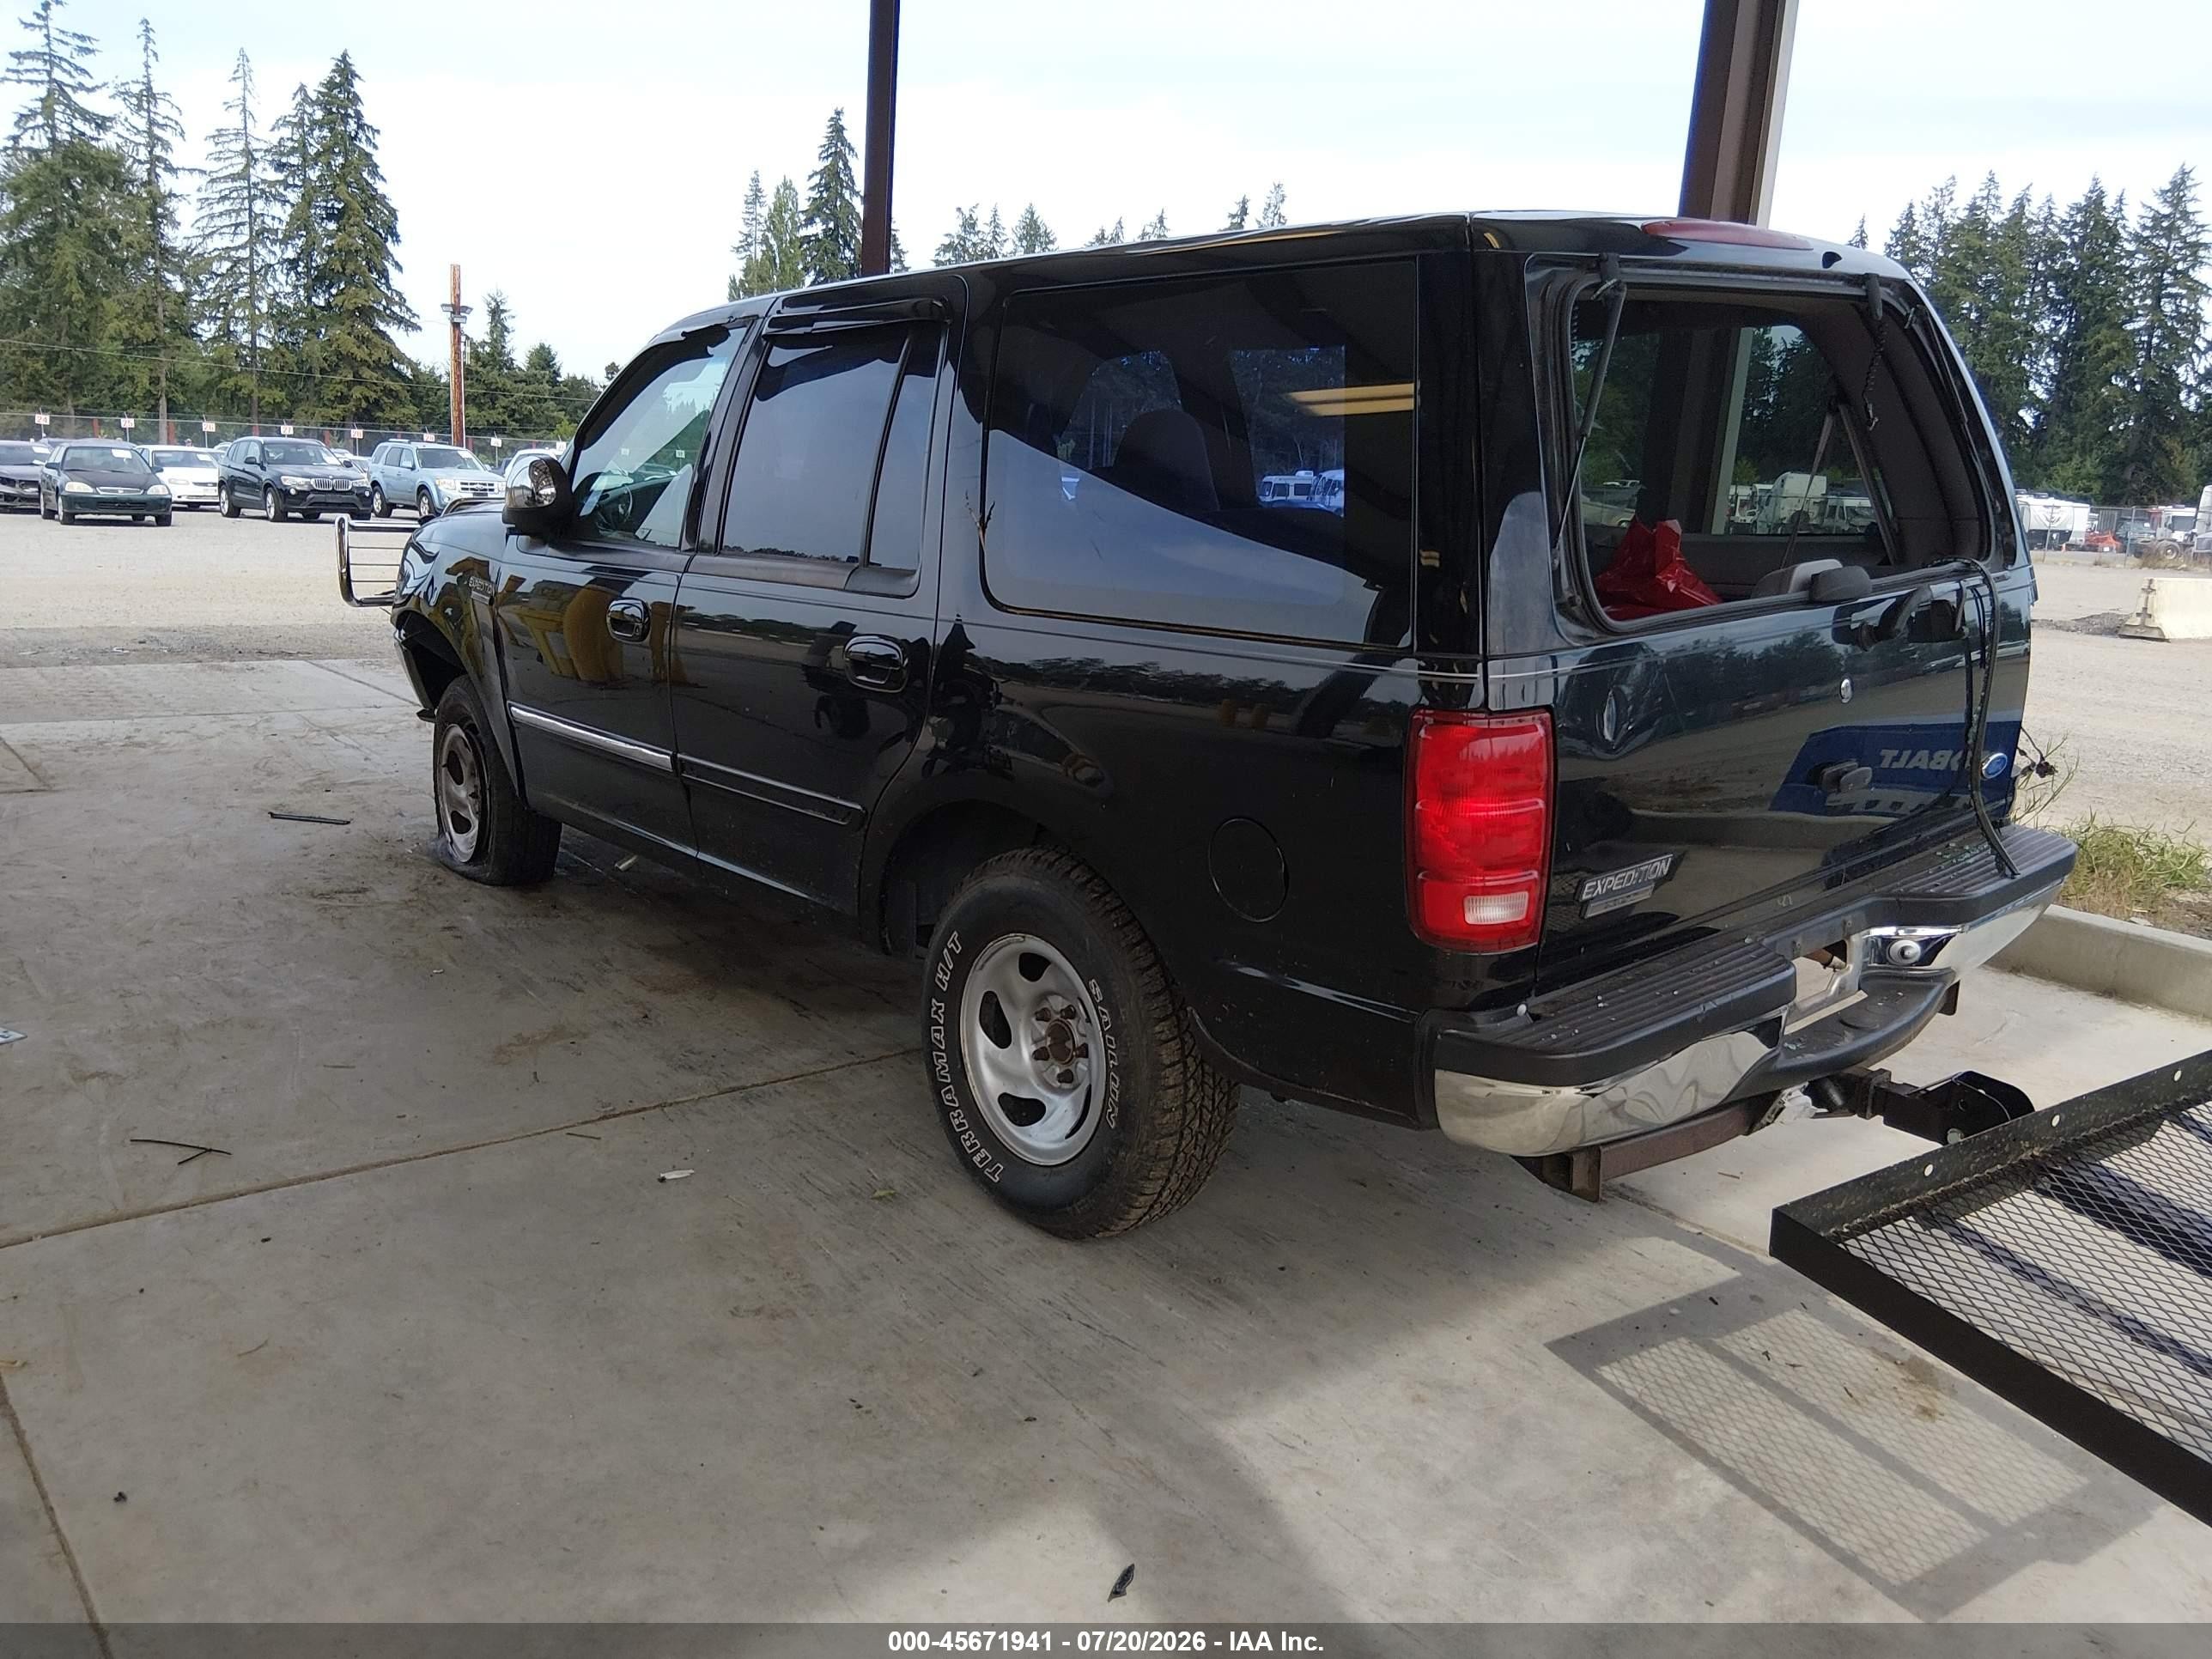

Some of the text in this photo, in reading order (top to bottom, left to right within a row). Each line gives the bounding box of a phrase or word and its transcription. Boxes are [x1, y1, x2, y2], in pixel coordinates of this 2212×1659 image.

[1582, 857, 1672, 901] EXPEDITION
[931, 931, 1004, 1183] TERRAMAX H/T
[1089, 979, 1120, 1129] SAILUN
